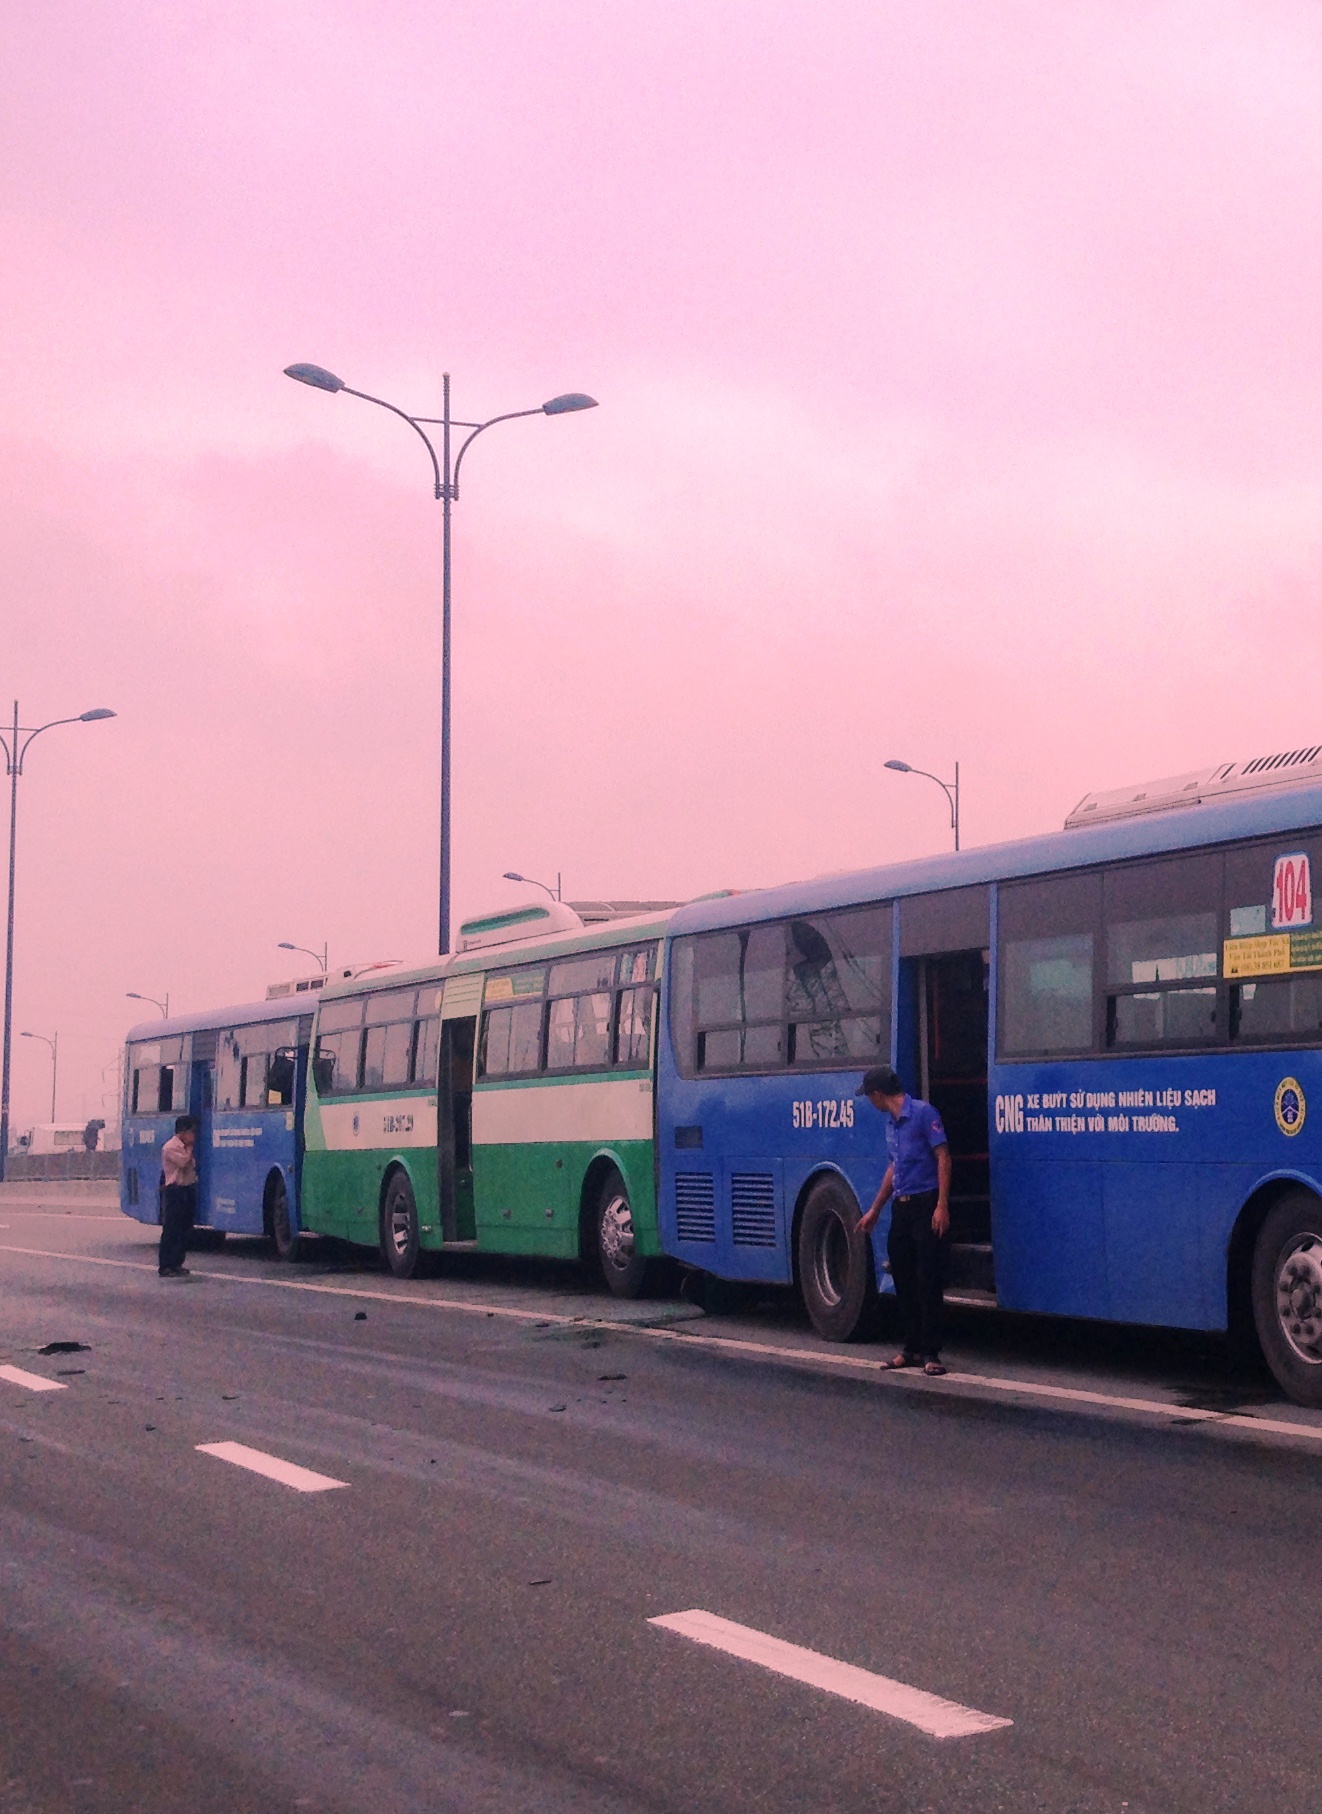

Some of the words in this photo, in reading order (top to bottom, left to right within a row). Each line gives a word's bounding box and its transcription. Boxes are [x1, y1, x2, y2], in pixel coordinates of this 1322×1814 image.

[1276, 859, 1307, 923] 104
[792, 1099, 854, 1129] 51B-172.45
[995, 1094, 1024, 1134] CNG
[1027, 1093, 1041, 1109] XE
[1086, 1092, 1116, 1111] DỤNG
[1118, 1088, 1154, 1108] NHIÊN
[1156, 1087, 1182, 1110] LIỆU
[1184, 1088, 1216, 1110] SẠCH
[1027, 1114, 1053, 1132] THÂN
[1055, 1113, 1086, 1135] THIỆN
[1107, 1113, 1129, 1132] MÔI
